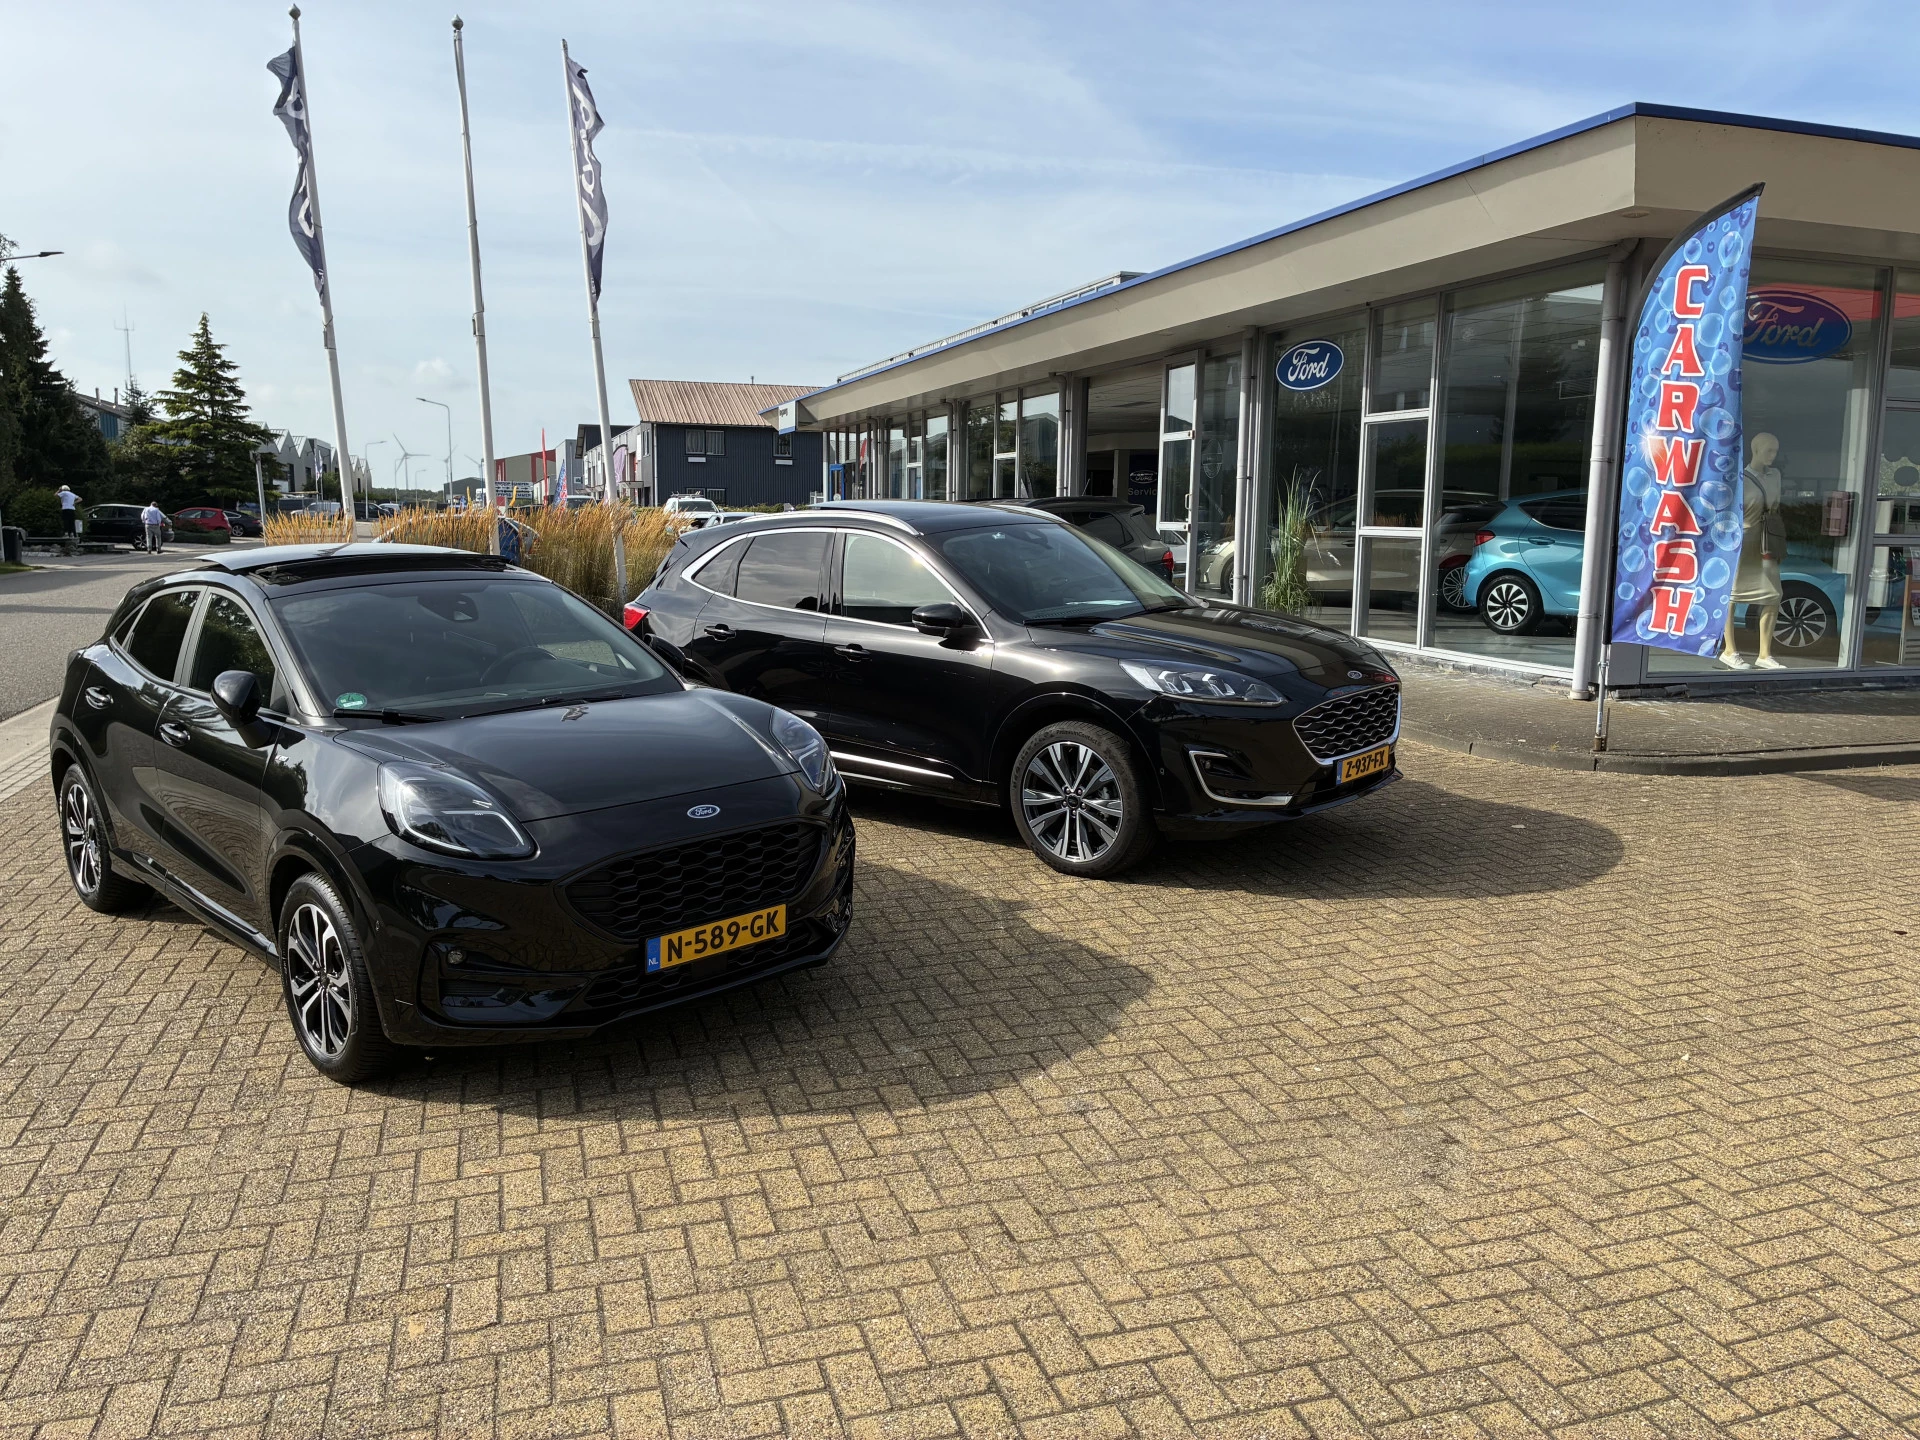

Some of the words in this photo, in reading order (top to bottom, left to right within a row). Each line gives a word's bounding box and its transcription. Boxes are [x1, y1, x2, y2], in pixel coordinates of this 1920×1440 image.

[1744, 301, 1824, 347] Ford
[1288, 347, 1330, 381] Ford
[1648, 264, 1710, 636] CARWASH
[1128, 487, 1158, 496] Servic
[1345, 750, 1385, 778] Z-937-FX
[667, 909, 779, 962] N-589-GK
[648, 957, 659, 966] NL
